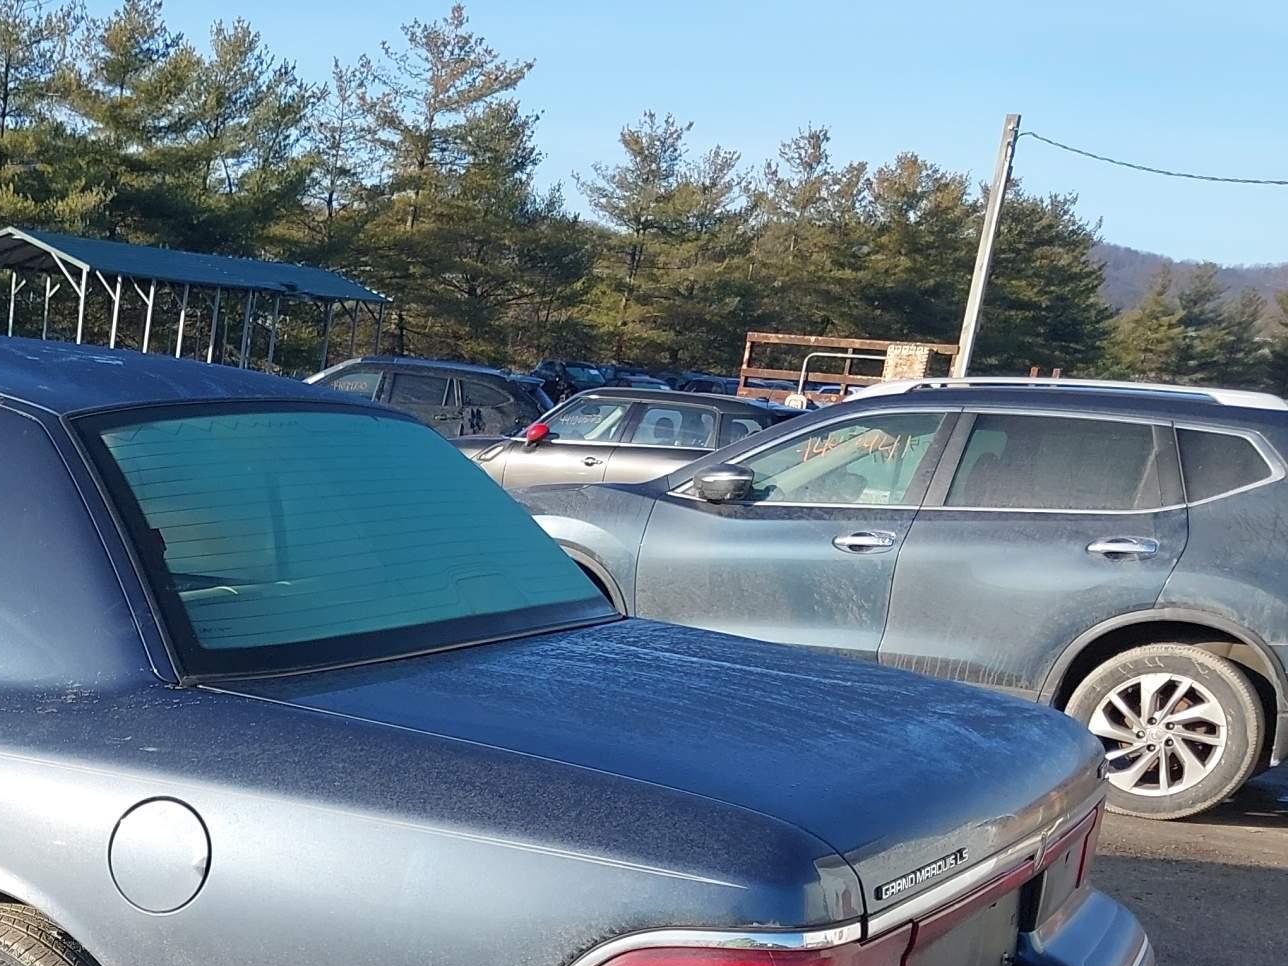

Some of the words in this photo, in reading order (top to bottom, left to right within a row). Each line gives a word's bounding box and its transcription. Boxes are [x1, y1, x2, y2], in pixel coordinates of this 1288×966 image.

[882, 874, 915, 899] GRAND
[916, 855, 955, 884] MARQUIS
[956, 848, 969, 865] LS
